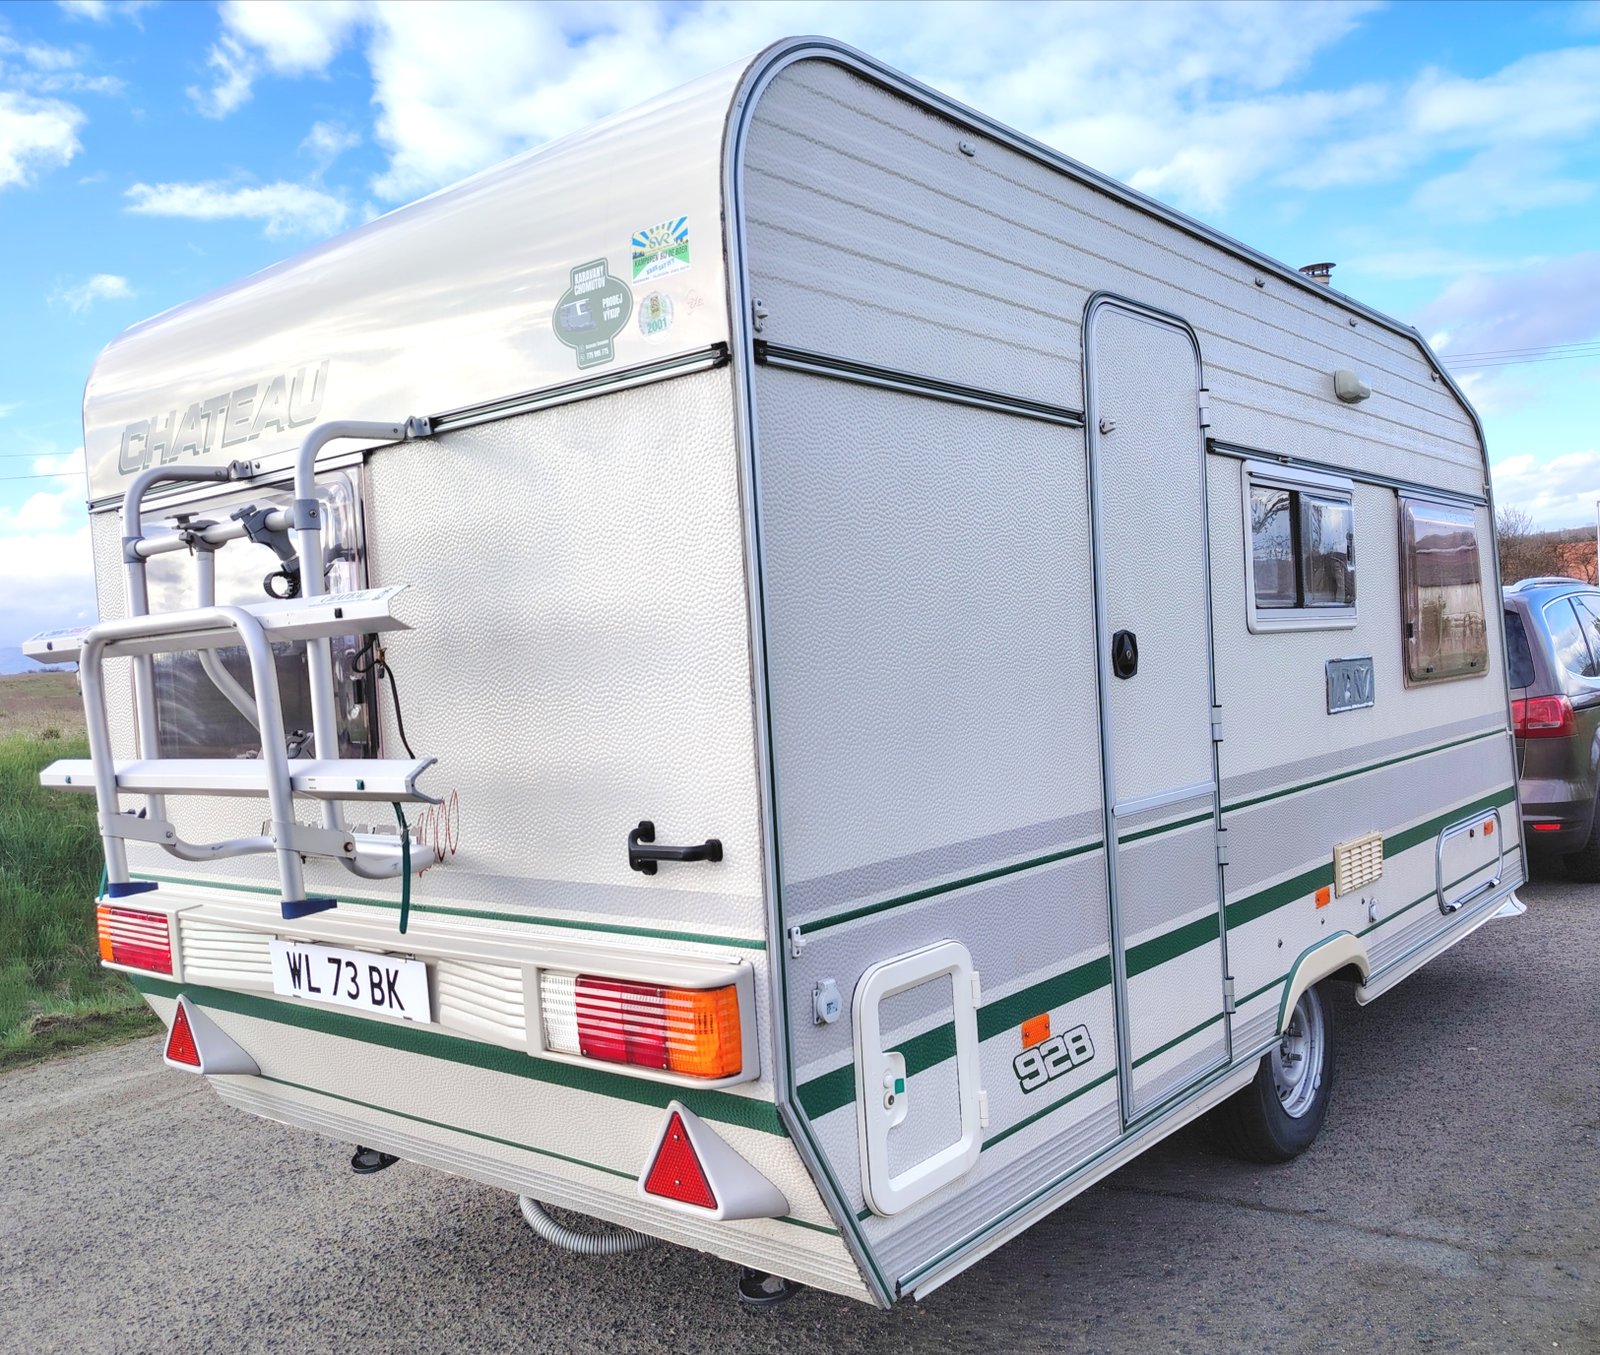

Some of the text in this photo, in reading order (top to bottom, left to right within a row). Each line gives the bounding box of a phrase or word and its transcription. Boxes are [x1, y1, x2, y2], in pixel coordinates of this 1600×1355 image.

[649, 232, 670, 249] SVR
[574, 265, 604, 285] KARAVANY
[574, 276, 605, 296] CHOMUTOV
[602, 293, 623, 308] PRODEJ
[646, 317, 668, 334] 2001
[118, 360, 330, 476] CHATEAU
[286, 951, 405, 1011] WL 73 BK
[1013, 1024, 1095, 1094] 928
